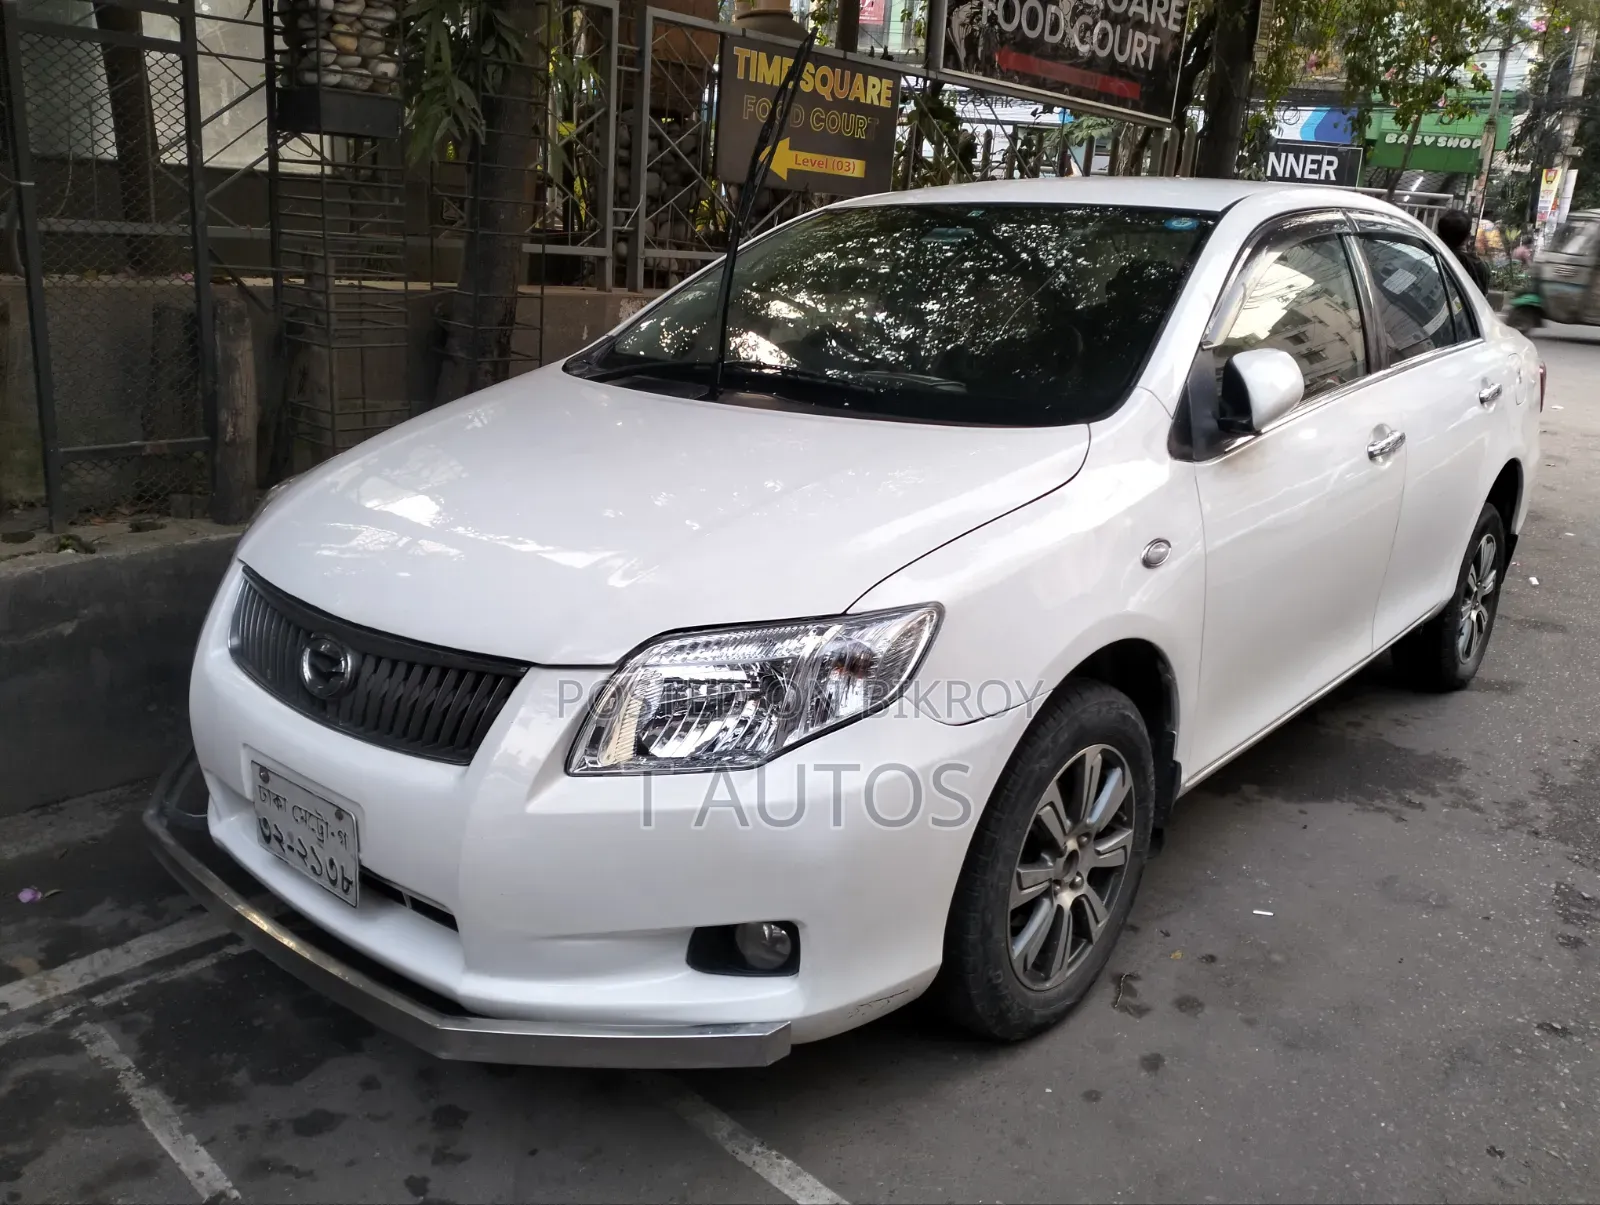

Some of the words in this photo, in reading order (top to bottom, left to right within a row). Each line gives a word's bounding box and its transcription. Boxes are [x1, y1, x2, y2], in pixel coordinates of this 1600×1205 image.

[1086, 0, 1184, 32] ARE
[982, 0, 1065, 44] FOOD
[1074, 14, 1161, 71] COURT
[800, 62, 894, 108] SQUARE
[809, 107, 879, 141] COURT
[1385, 132, 1435, 147] BABY
[1437, 136, 1482, 149] SHOP
[794, 153, 828, 170] Level
[831, 157, 856, 174] (03)
[258, 784, 287, 812] ঢাকা
[258, 816, 354, 894] ৩২-২১৩৮
